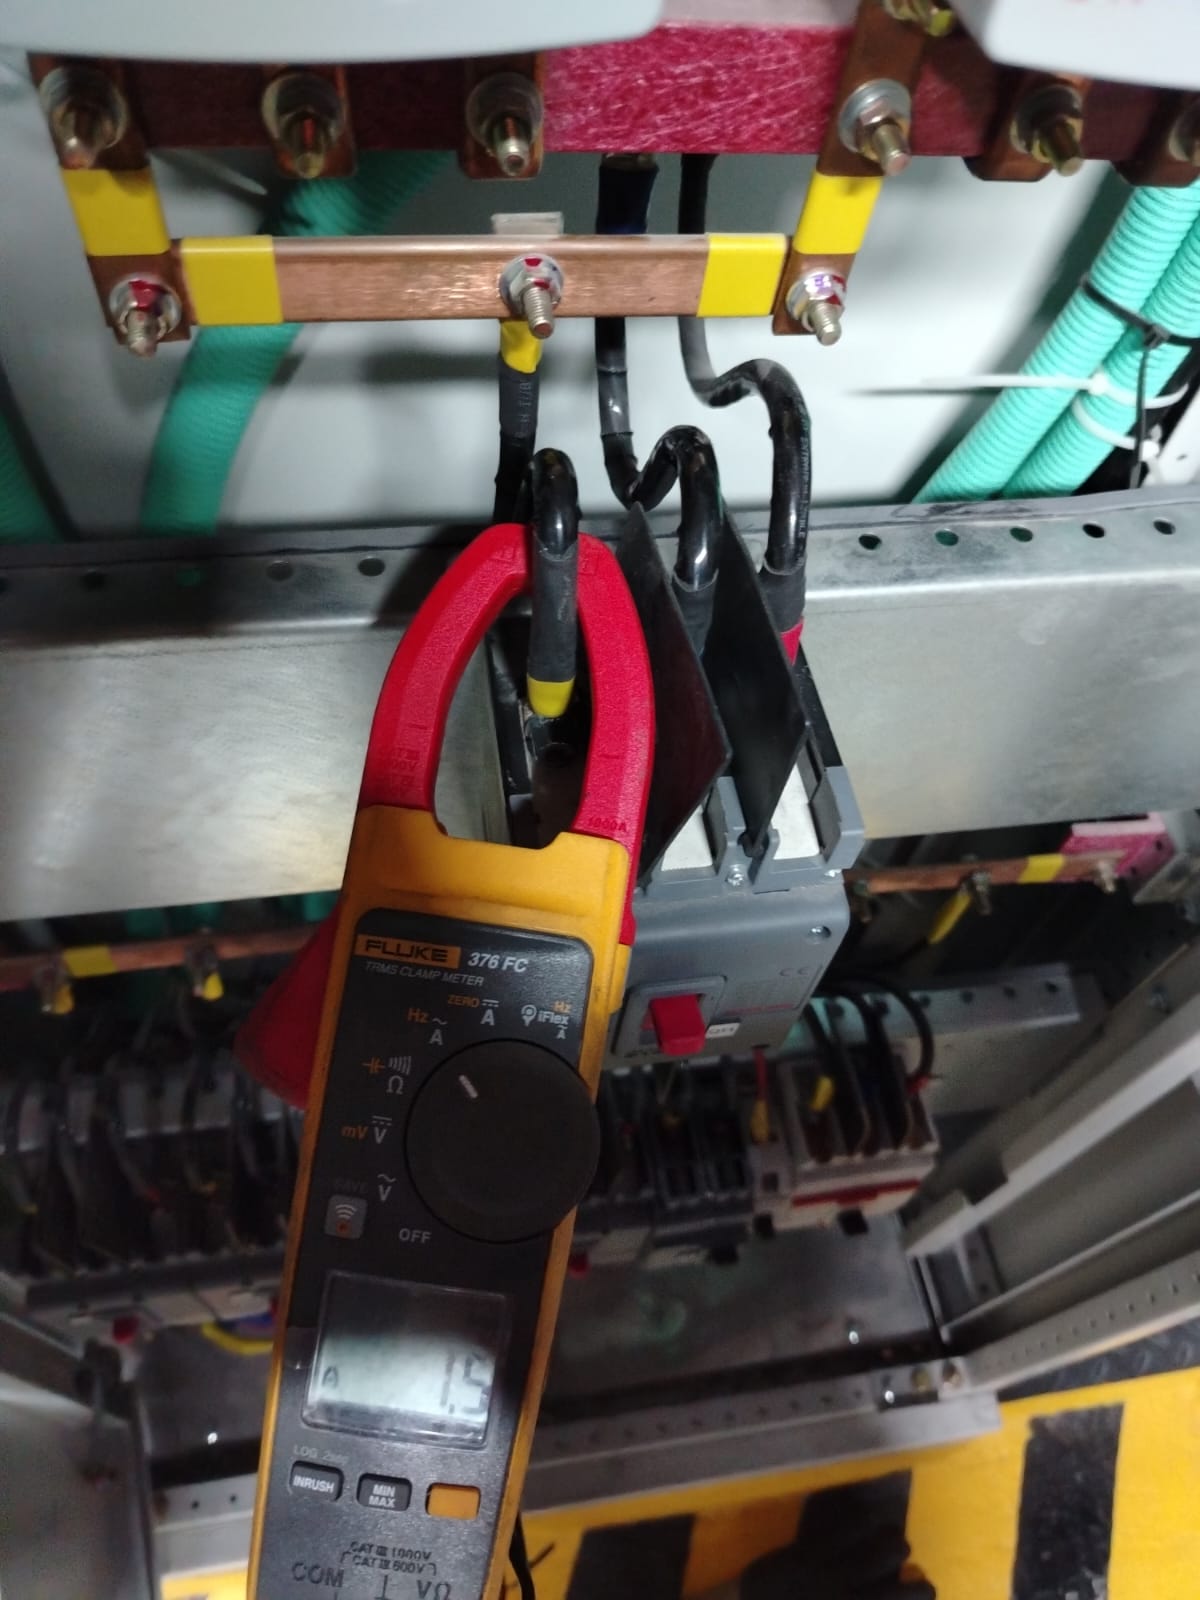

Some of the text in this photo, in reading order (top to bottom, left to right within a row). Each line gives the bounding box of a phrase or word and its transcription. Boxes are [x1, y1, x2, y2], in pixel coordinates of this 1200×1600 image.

[366, 939, 449, 962] FLUKE
[468, 952, 529, 973] 376 FC
[366, 960, 485, 986] TRMS CLAMP METER
[447, 995, 480, 1008] ZERO
[554, 1000, 571, 1014] Hz
[407, 1007, 430, 1023] Hz
[537, 1010, 570, 1025] iFlex
[341, 1125, 369, 1139] mV
[398, 1227, 431, 1243] OFF
[322, 1352, 491, 1415] A 1.5
[292, 1474, 335, 1494] INRUSH
[372, 1483, 397, 1497] MIN
[368, 1495, 396, 1508] MAX
[350, 1541, 374, 1554] CAT
[352, 1555, 376, 1567] CAT
[292, 1562, 345, 1588] COM
